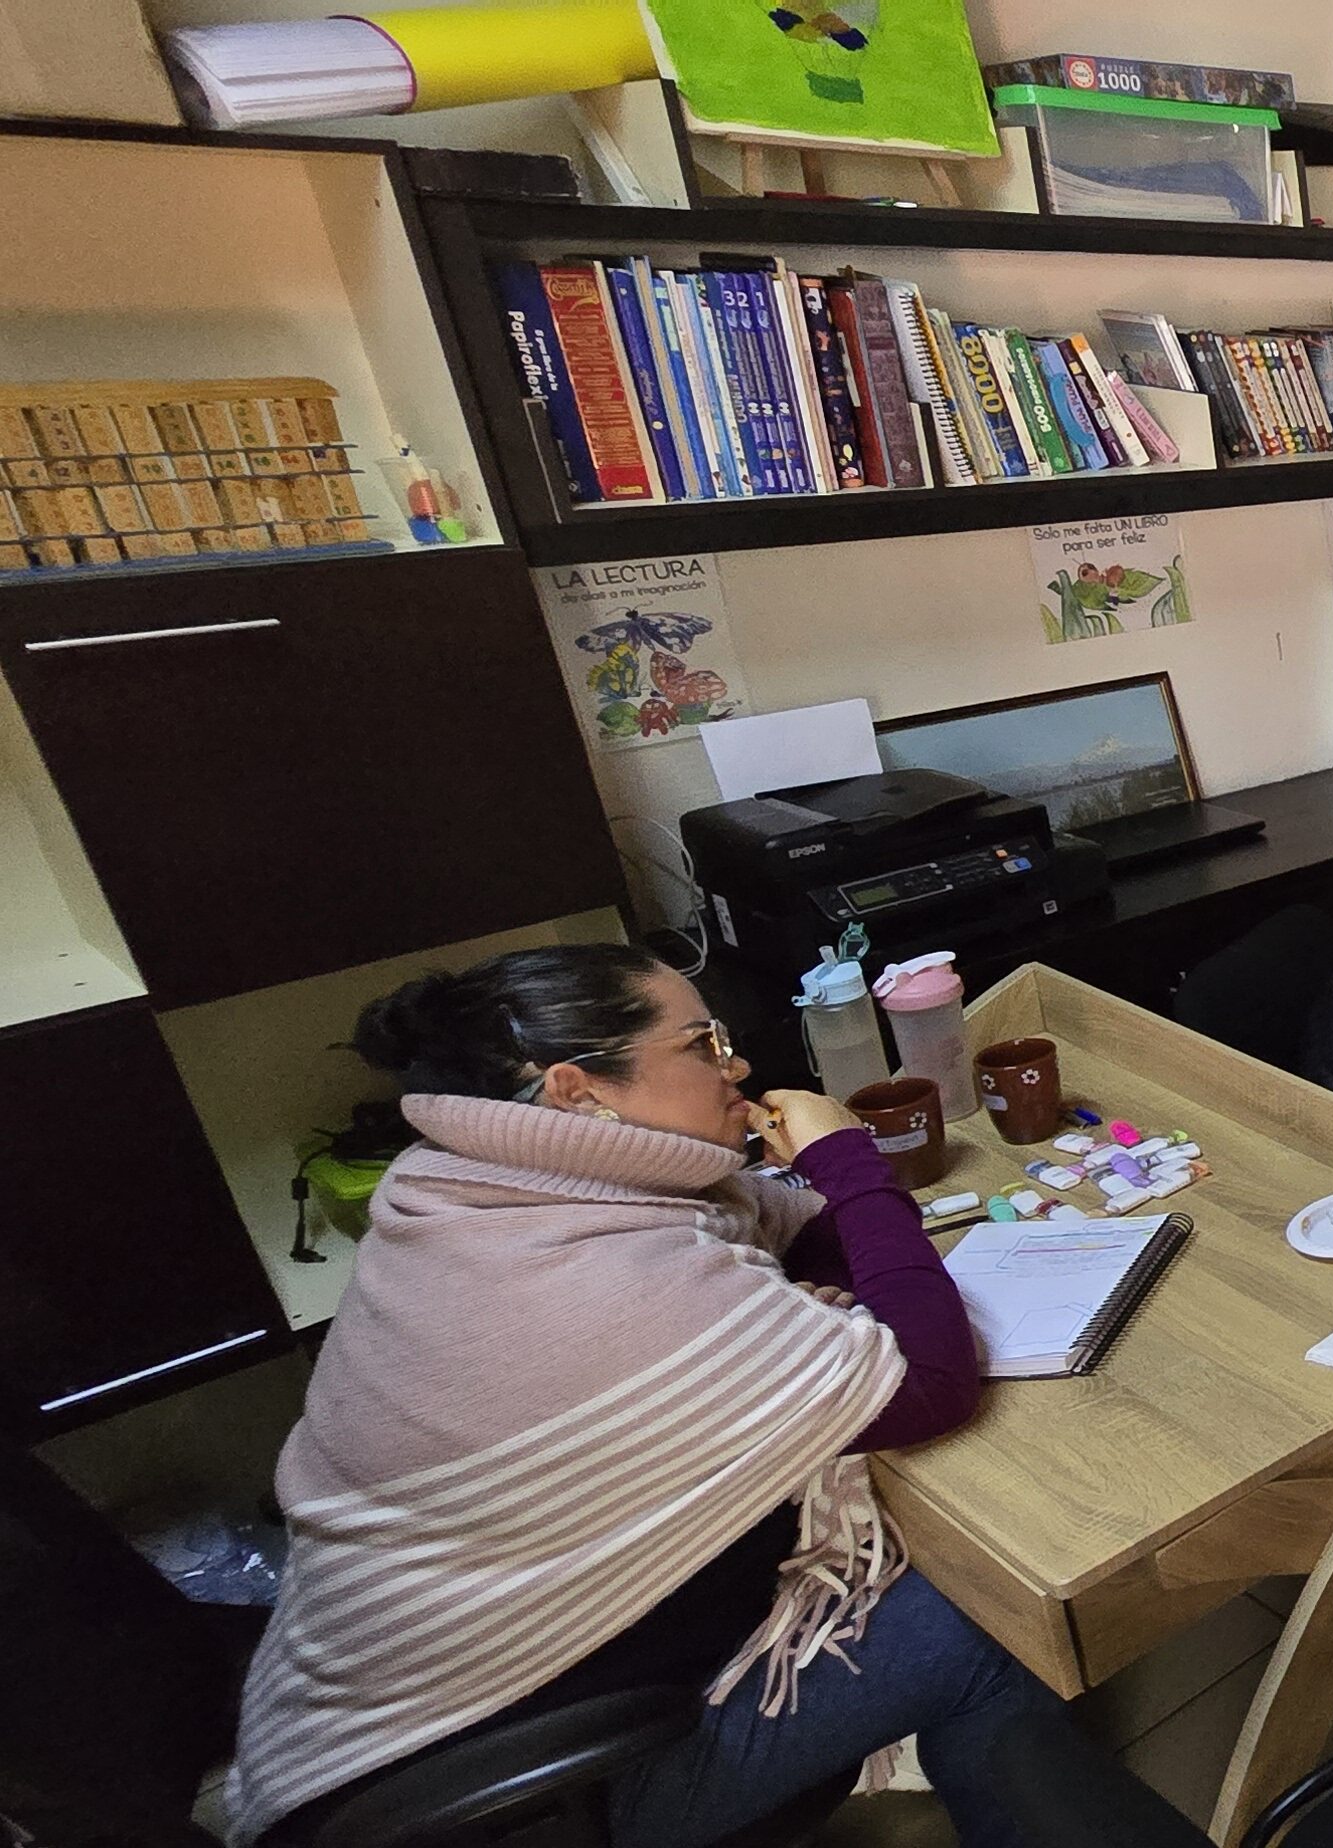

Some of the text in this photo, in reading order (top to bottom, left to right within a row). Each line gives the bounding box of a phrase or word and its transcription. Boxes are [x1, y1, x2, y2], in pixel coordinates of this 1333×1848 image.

[1097, 72, 1141, 91] 1000
[723, 290, 736, 306] 3
[736, 291, 749, 307] 2
[756, 291, 765, 306] 1
[507, 310, 550, 401] Papiroflexi
[961, 335, 1004, 413] 8000
[1034, 405, 1053, 433] 500
[1032, 514, 1169, 541] Solo me falta UN LIBRO
[1062, 532, 1146, 555] para ser feliz
[551, 558, 705, 590] LA LECTURA
[561, 592, 578, 604] de
[580, 590, 606, 602] alas
[609, 590, 618, 599] a
[621, 587, 634, 597] mi
[788, 843, 826, 859] EPSON
